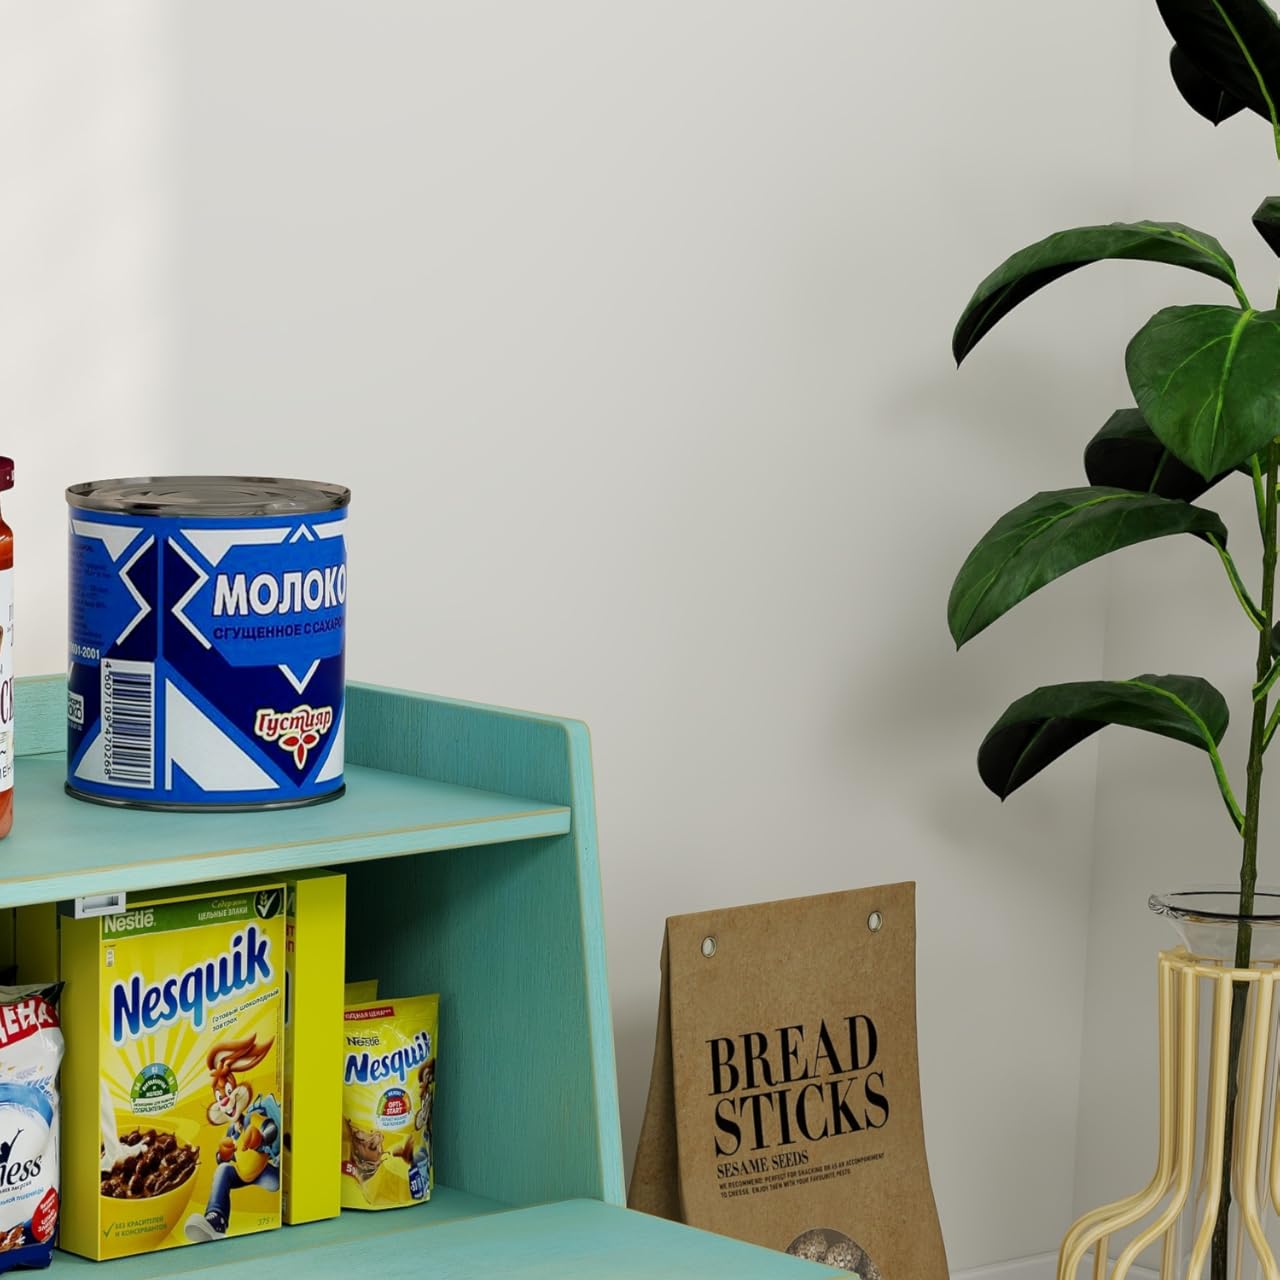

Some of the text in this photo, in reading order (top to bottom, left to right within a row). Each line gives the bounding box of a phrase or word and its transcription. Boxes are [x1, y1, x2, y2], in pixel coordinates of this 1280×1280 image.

[212, 563, 348, 617] МОЛОКО
[213, 622, 301, 641] СГУЩЕННОЕ
[257, 704, 333, 737] Густияр
[113, 926, 271, 1042] Nesquik
[704, 1013, 878, 1097] BREAD
[713, 1071, 890, 1158] STICKS
[716, 1149, 809, 1180] SESAME SEEDS
